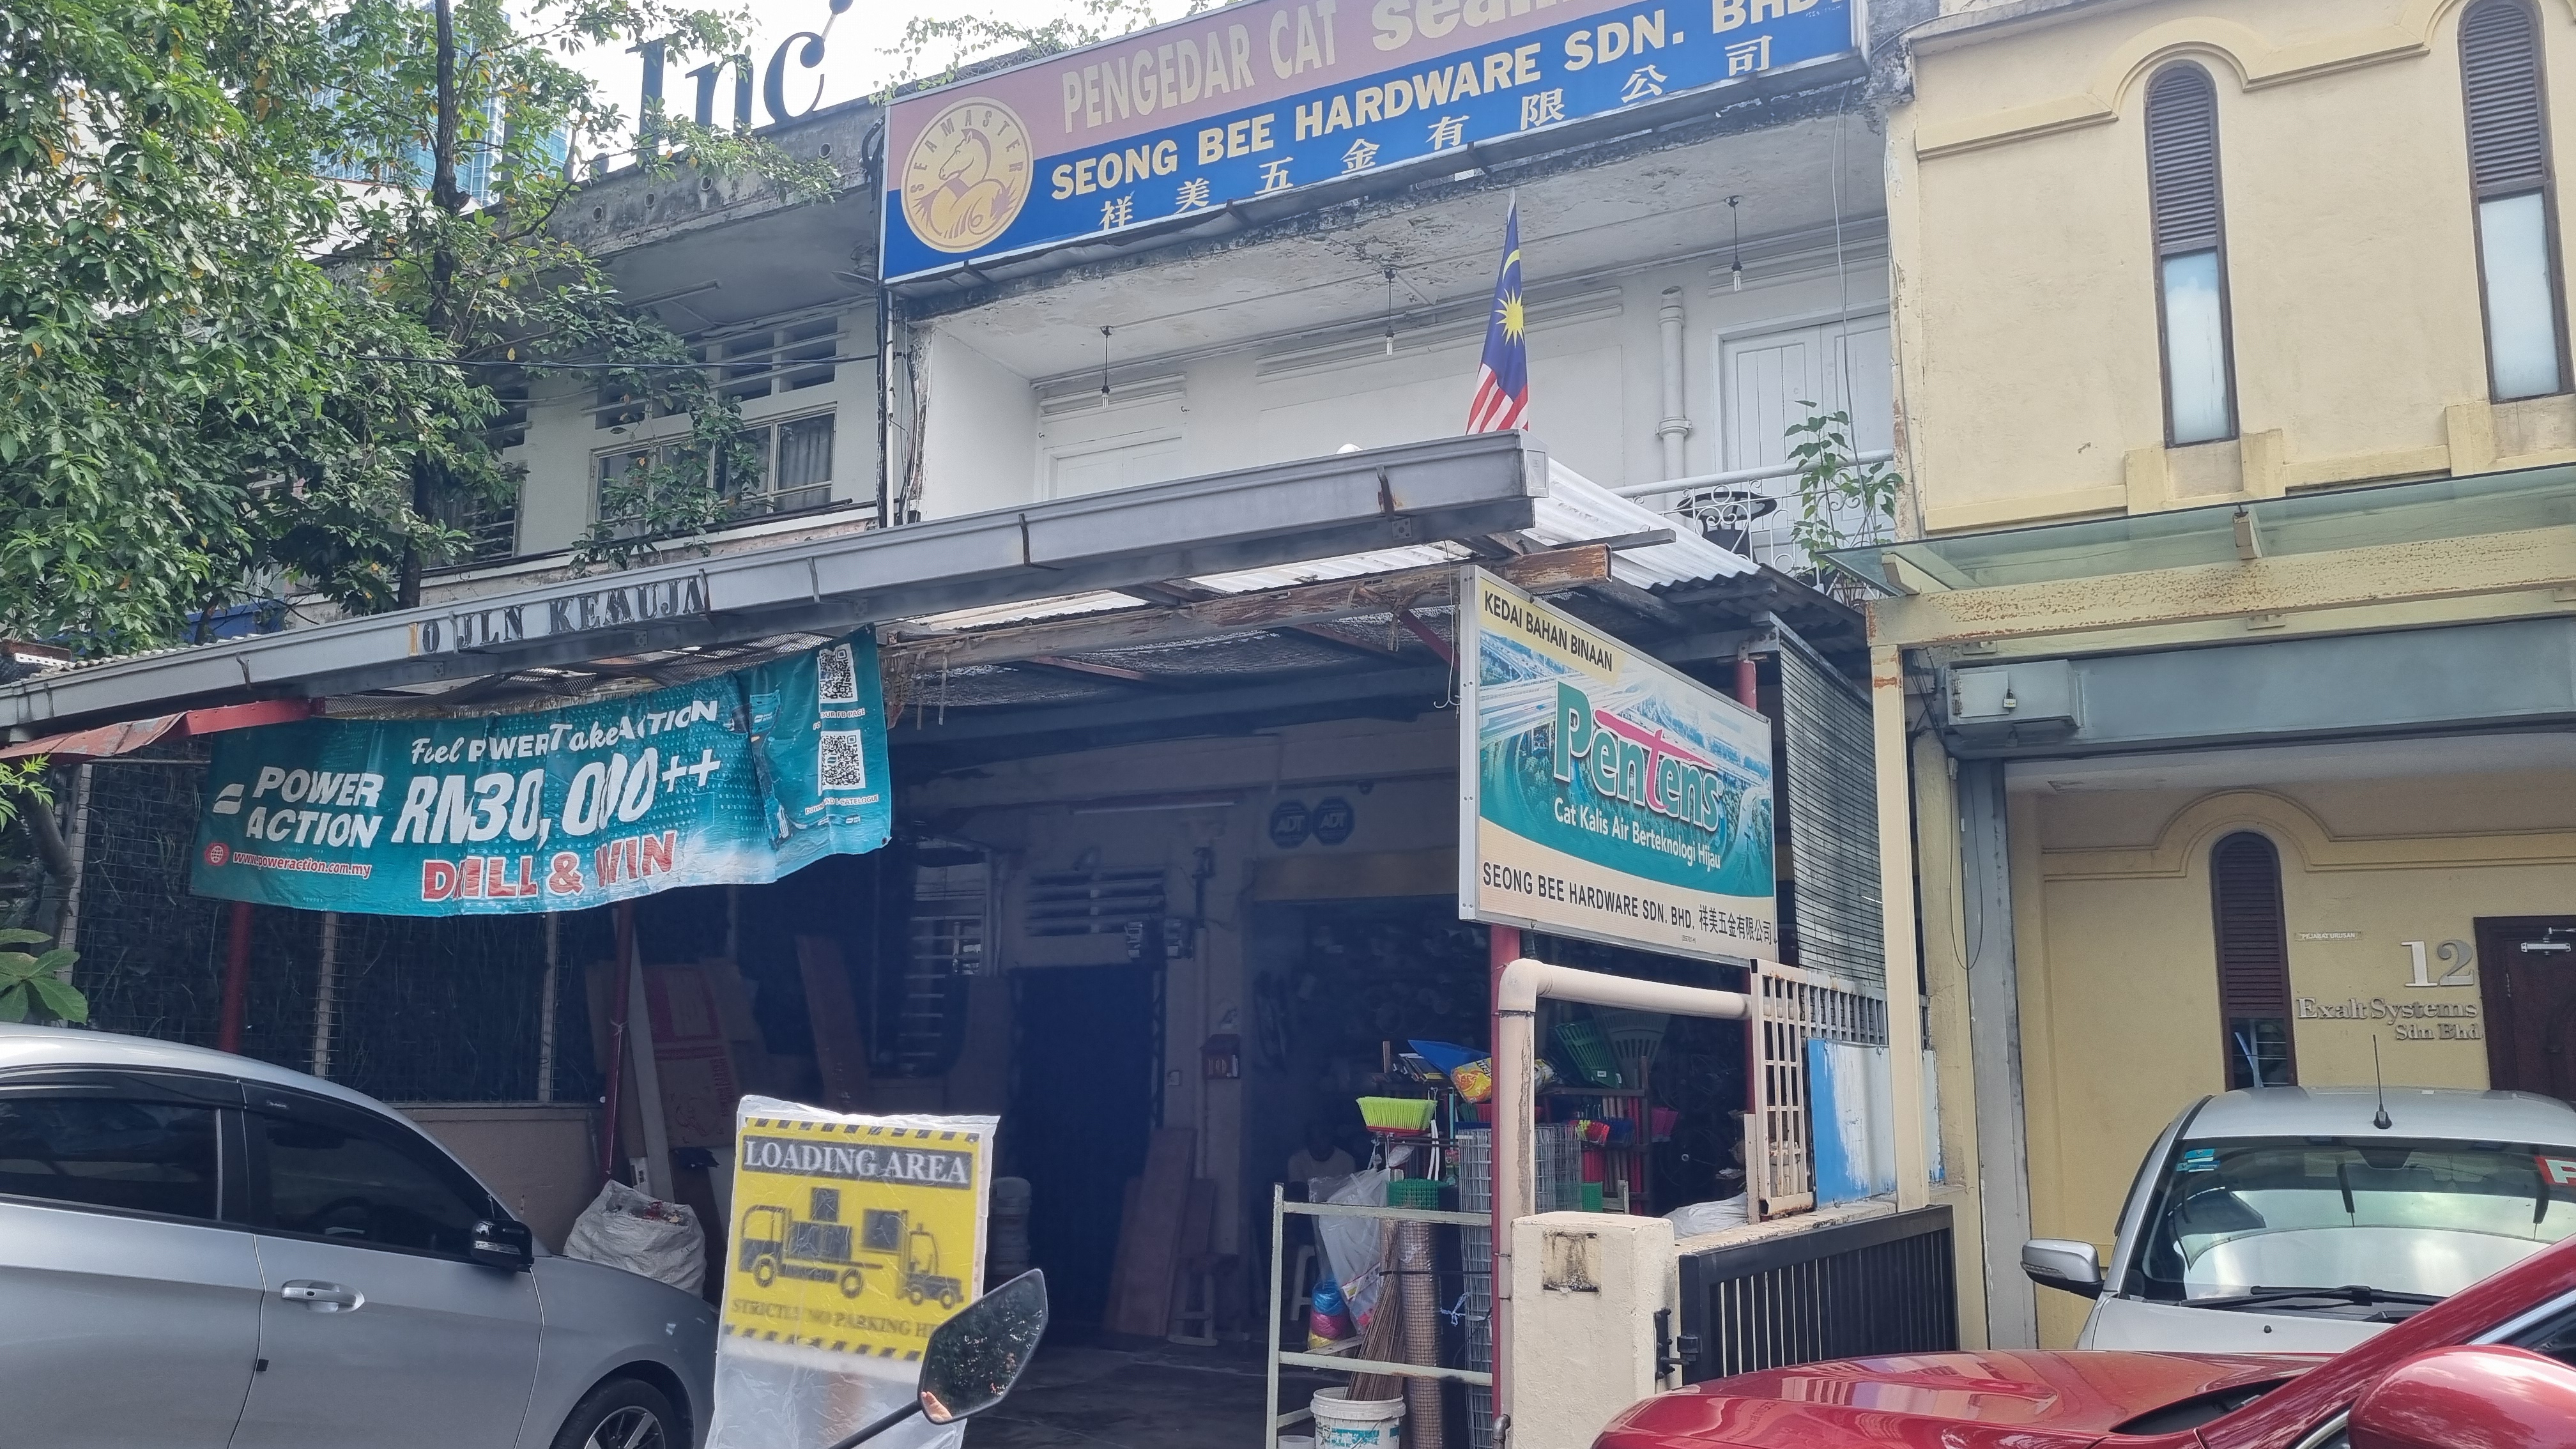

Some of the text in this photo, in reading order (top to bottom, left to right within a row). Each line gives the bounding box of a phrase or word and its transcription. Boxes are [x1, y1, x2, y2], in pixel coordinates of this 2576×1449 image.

[1062, 22, 1256, 134] PENGEDAR
[1269, 2, 1337, 80] CAT
[1052, 139, 1178, 200] SEONG
[1199, 114, 1275, 166] BEE
[1296, 43, 1541, 141] HARDWARE
[1564, 10, 1684, 71] SDN.
[910, 109, 1023, 194] SEAMASTER
[457, 604, 526, 648] JLN
[549, 576, 704, 633] KEMUJA
[1485, 590, 1613, 671] KEDAI BAHAN BINAAN
[847, 707, 865, 718] PAGE
[411, 737, 464, 764] Feel
[549, 721, 620, 751] Take
[1553, 681, 1721, 832] Pentens
[253, 767, 384, 807] POWER
[246, 807, 383, 848] ACTION
[1275, 815, 1305, 833] ADT
[1319, 812, 1347, 829] ADT
[1554, 797, 1721, 872] Cat Kalis Air Berteknologi Hijau
[234, 852, 372, 879] www.poweraction.com.my
[546, 851, 585, 896] &
[594, 830, 678, 890] WIN
[1483, 862, 1772, 946] SEONG BEE HARDWARE SDN. BHD. 祥美五金有限公司
[2400, 939, 2474, 987] 12
[2296, 997, 2478, 1025] Exalt Systems
[2396, 1023, 2435, 1040] Sdn
[742, 1140, 969, 1185] LOADING AREA
